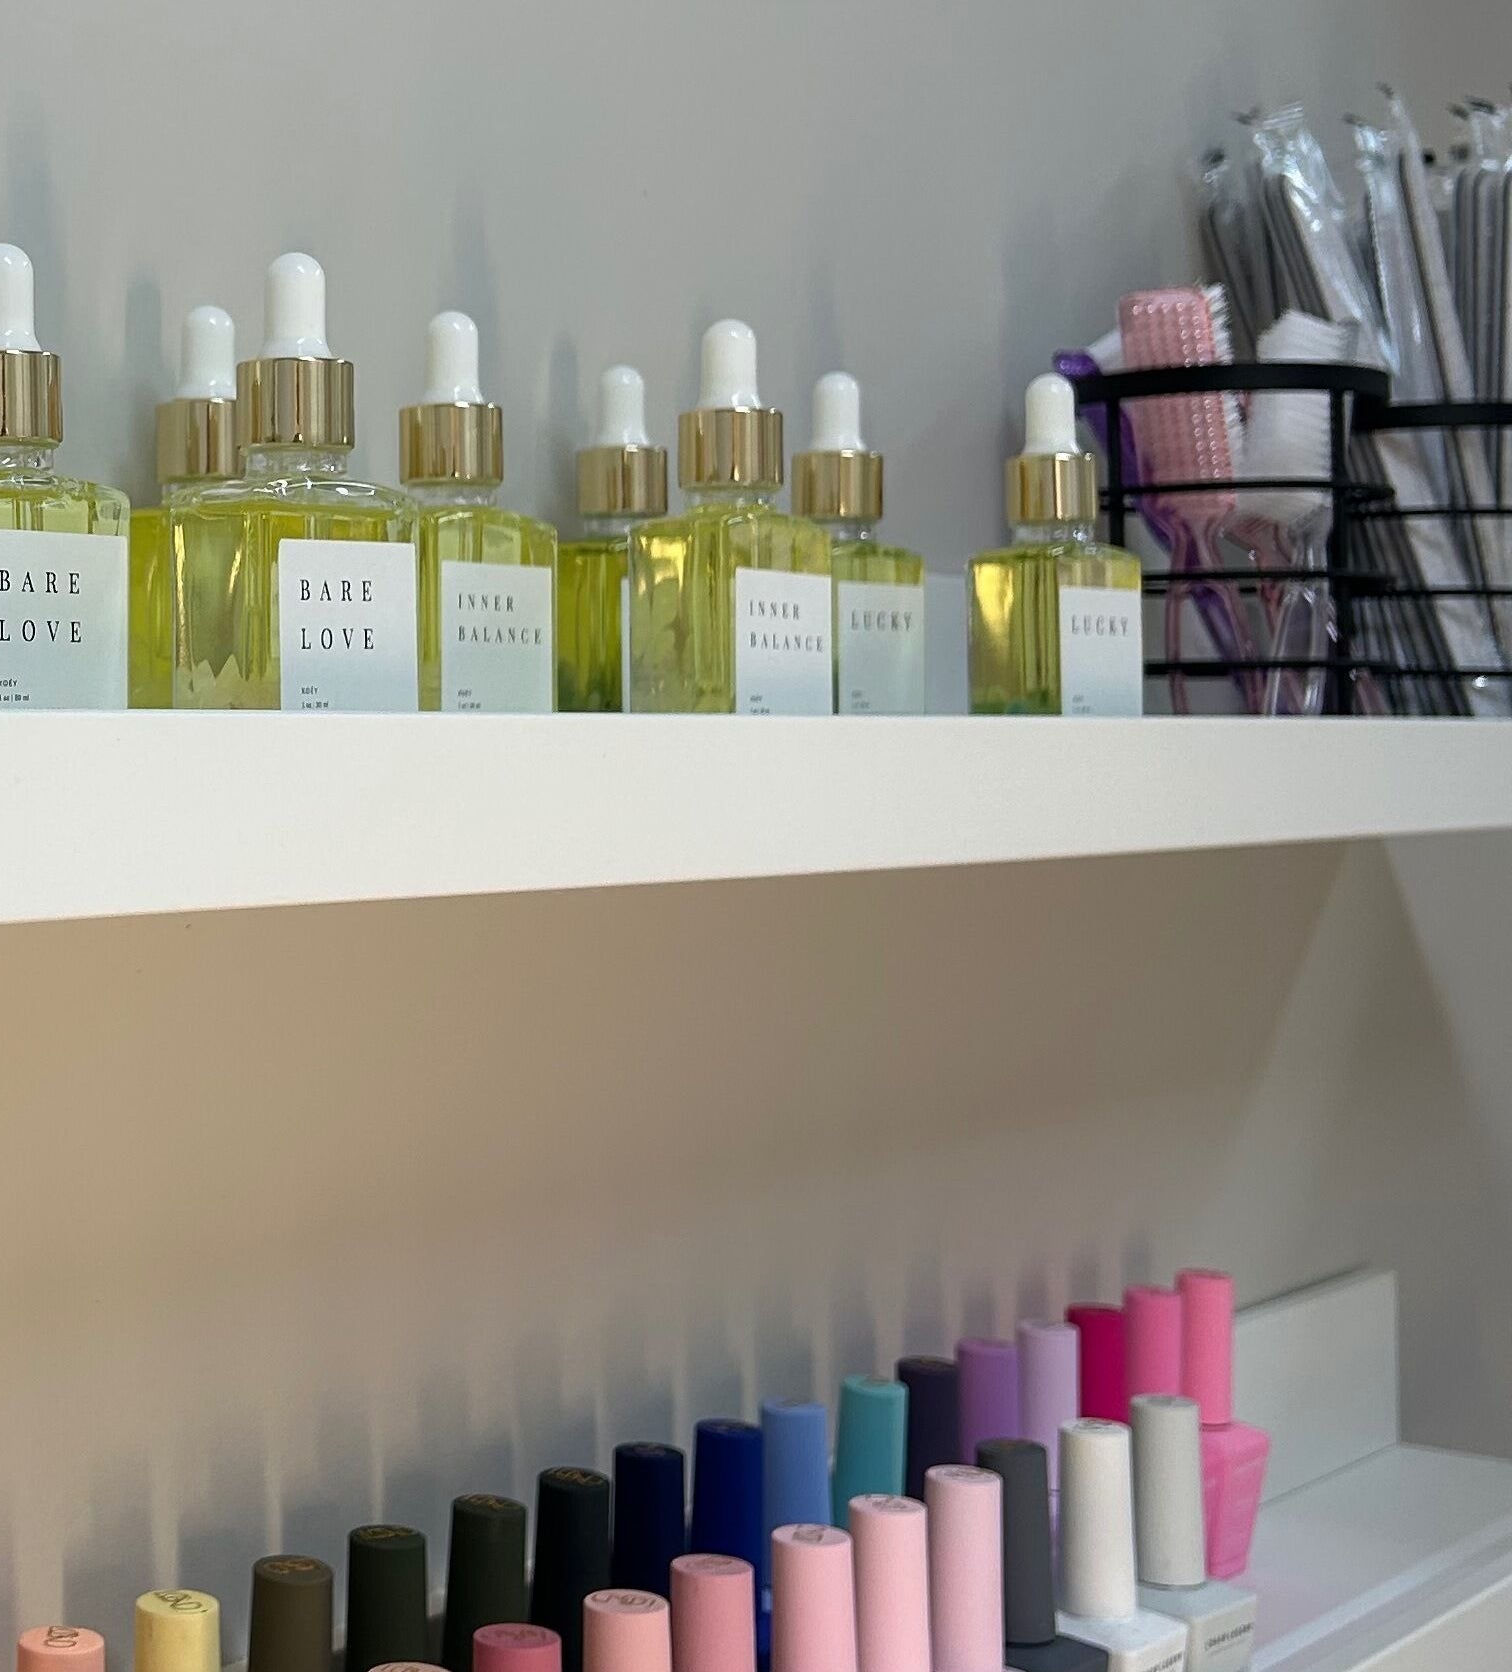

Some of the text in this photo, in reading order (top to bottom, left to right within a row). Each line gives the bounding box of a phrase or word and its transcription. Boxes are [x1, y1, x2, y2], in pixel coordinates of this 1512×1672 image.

[299, 579, 374, 602] BARE
[458, 593, 515, 613] INNER
[749, 600, 800, 620] INNER
[850, 610, 913, 633] LUCKY
[1071, 614, 1129, 637] LUCKY
[301, 628, 376, 650] LOVE
[458, 625, 542, 645] BALANCE
[750, 631, 824, 653] BALANCE
